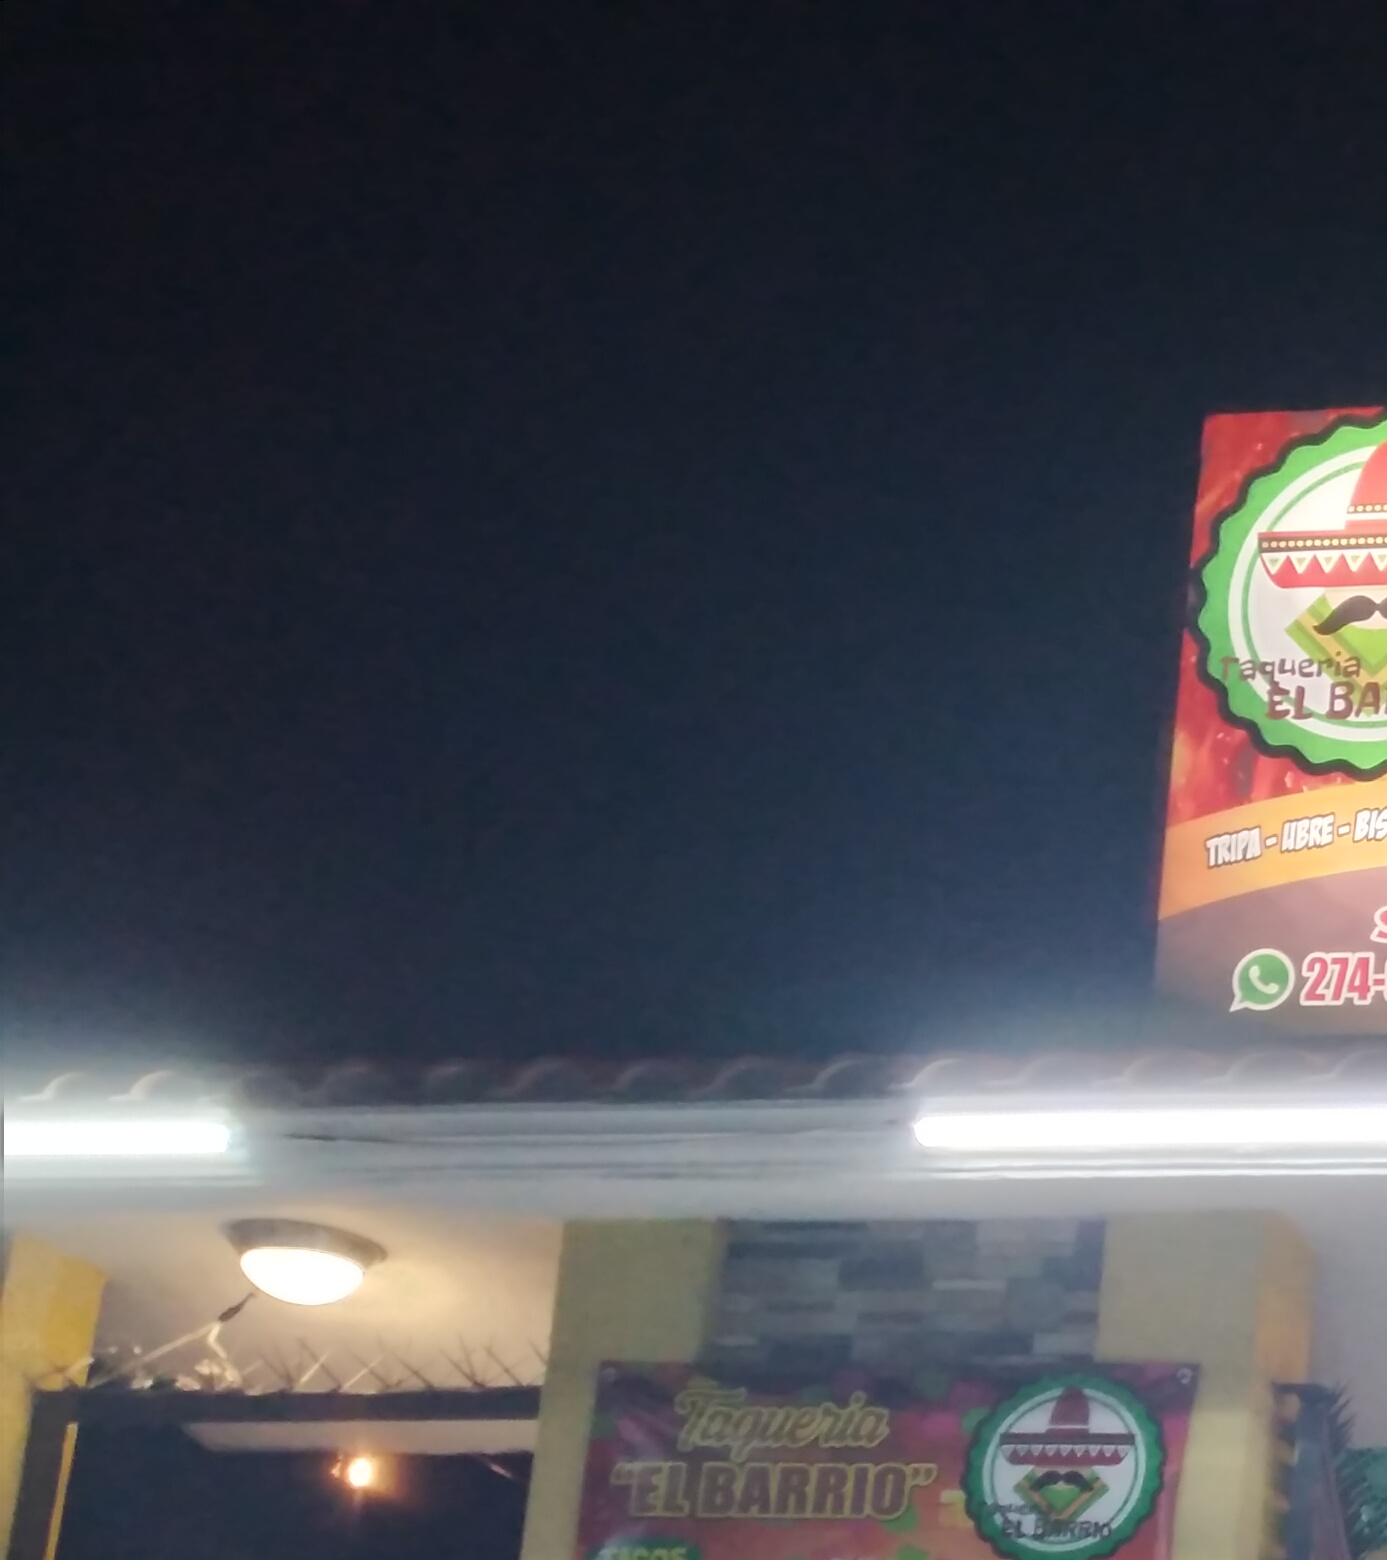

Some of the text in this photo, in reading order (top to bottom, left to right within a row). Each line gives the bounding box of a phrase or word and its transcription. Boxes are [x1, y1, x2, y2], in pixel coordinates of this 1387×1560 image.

[1220, 651, 1362, 687] Taqueria
[1266, 681, 1313, 720] EL
[1205, 827, 1263, 868] TRIPA
[674, 1387, 890, 1462] Taqueria
[1031, 1518, 1114, 1540] BARRIO
